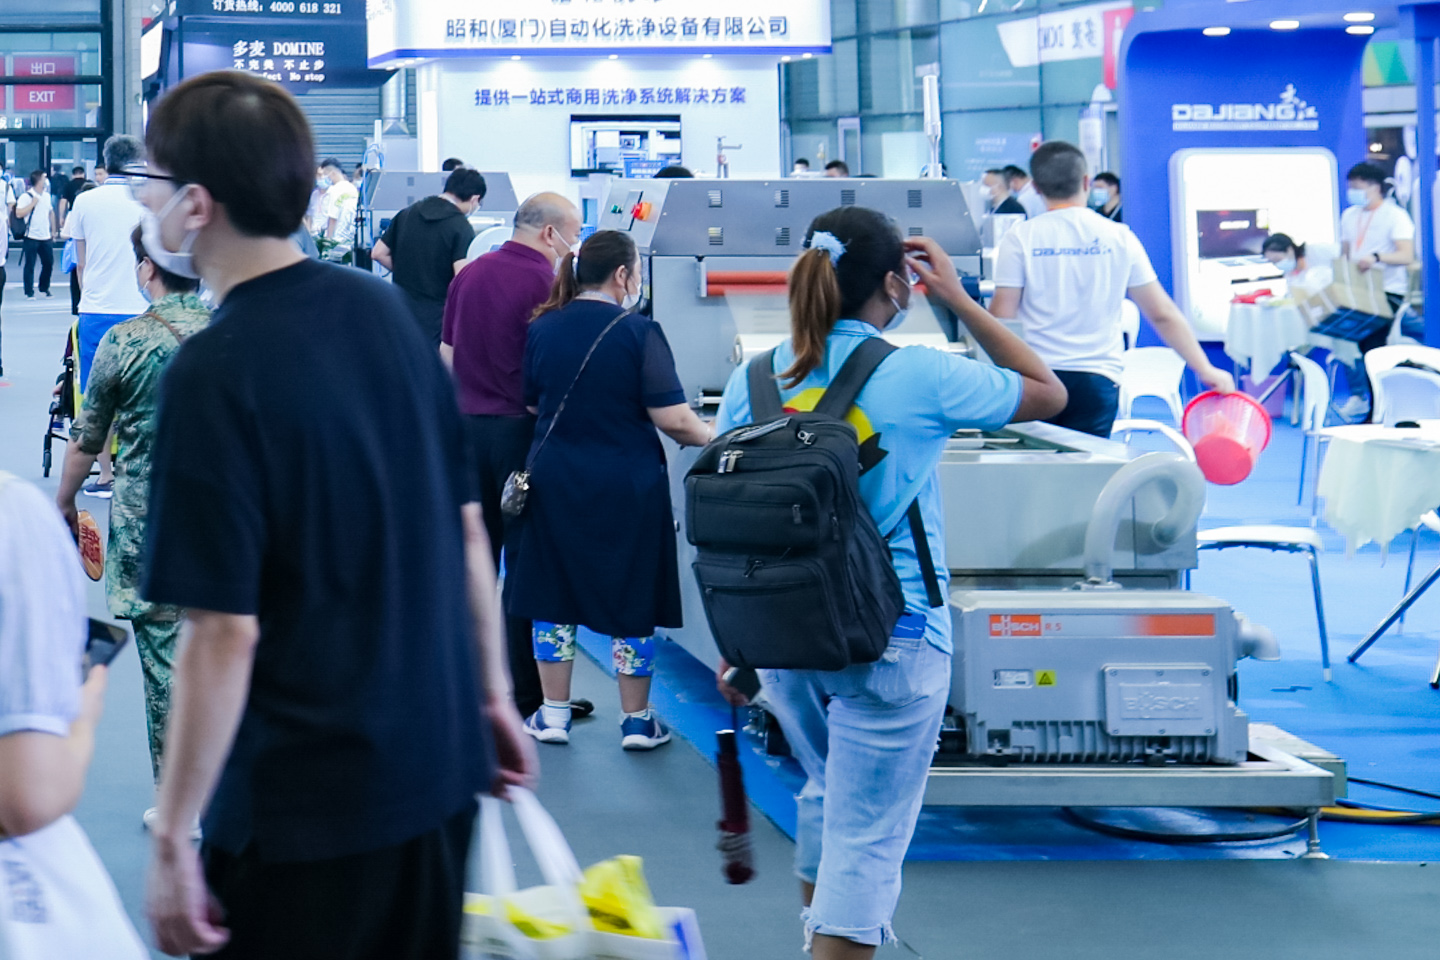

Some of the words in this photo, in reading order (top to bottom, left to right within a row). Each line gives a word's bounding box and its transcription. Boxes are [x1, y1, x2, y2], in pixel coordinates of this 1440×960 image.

[270, 1, 294, 12] 4000
[300, 3, 318, 13] 618
[323, 3, 342, 14] 321
[273, 42, 325, 56] DOMINE
[31, 62, 56, 75] 出口
[29, 91, 56, 102] EXIT
[475, 88, 747, 105] 提供一站式商用洗净系统解决方案
